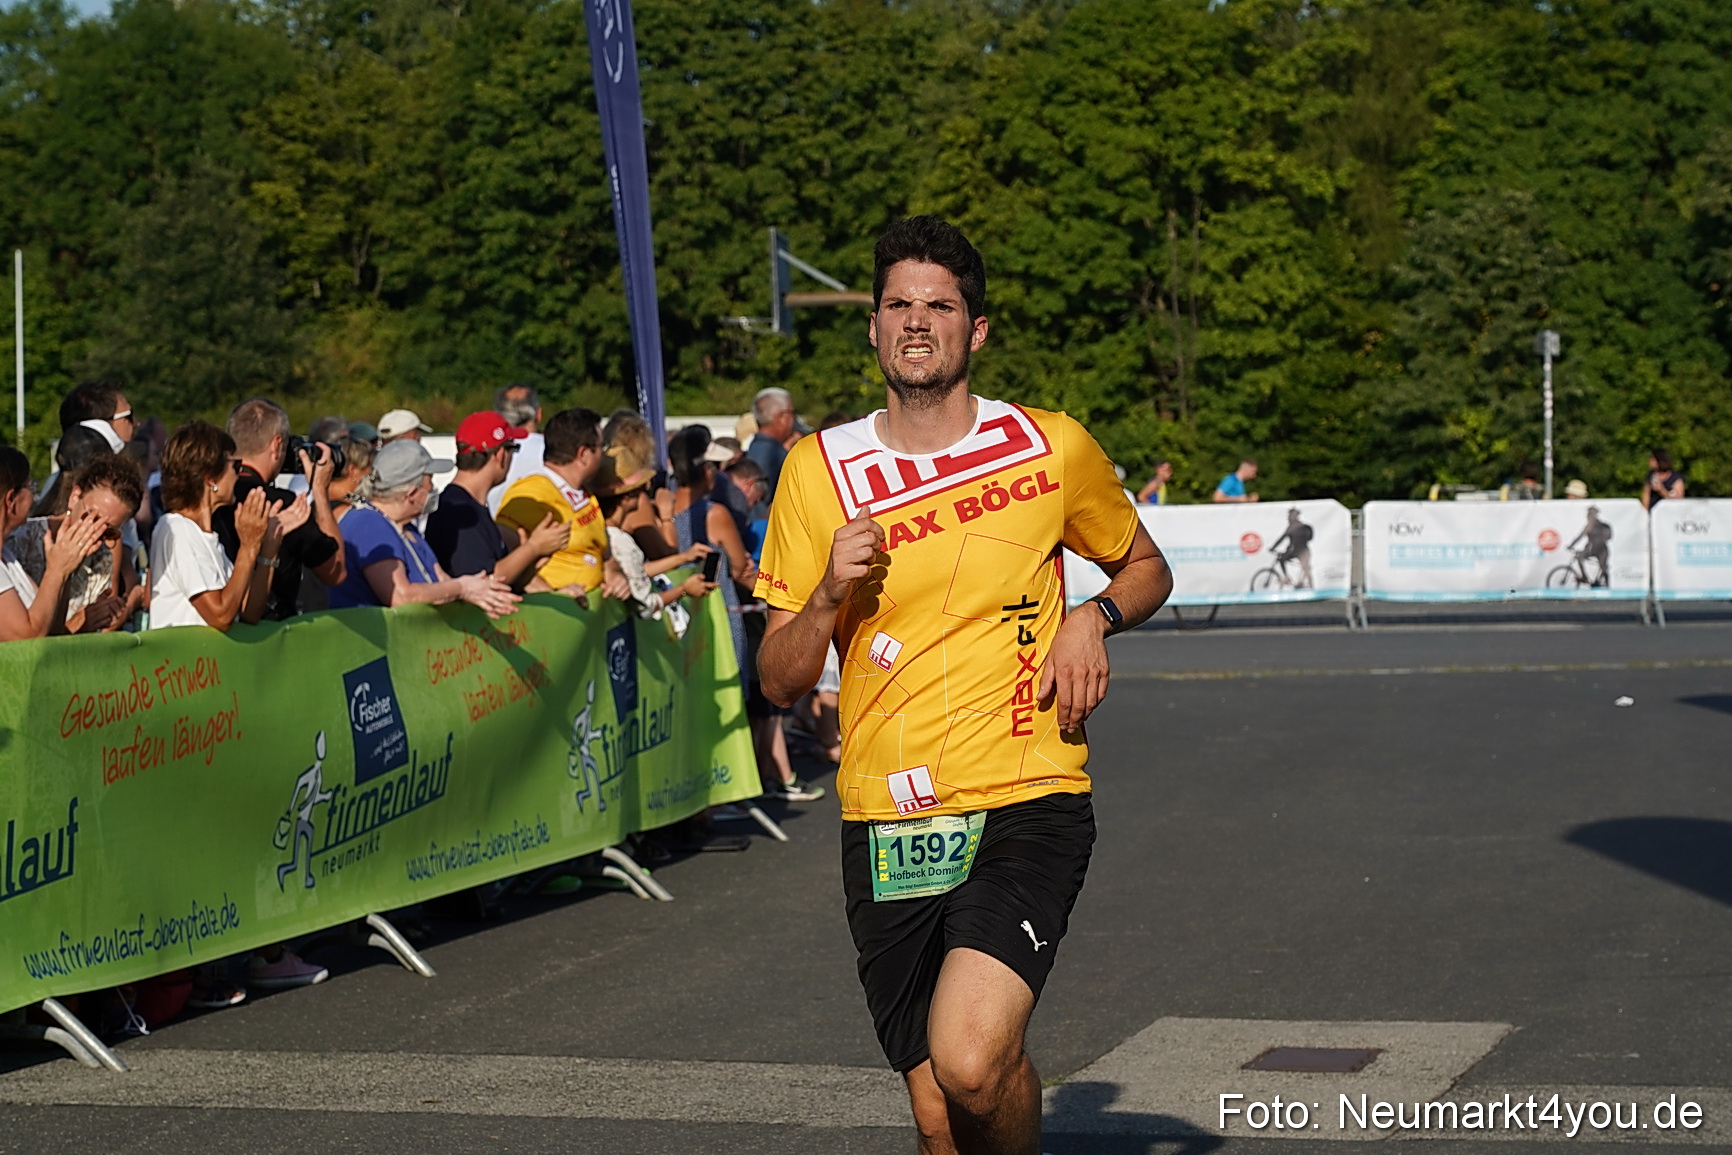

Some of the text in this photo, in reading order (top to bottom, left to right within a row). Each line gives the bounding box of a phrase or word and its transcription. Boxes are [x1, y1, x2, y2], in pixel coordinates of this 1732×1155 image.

[953, 470, 1060, 524] BÖGL
[60, 656, 221, 740] Gesunde Firmen
[359, 696, 393, 725] Fischer
[102, 690, 243, 786] laufen länger!
[324, 731, 454, 849] firmenlauf
[0, 796, 79, 898] lauf
[321, 831, 381, 878] neumarkt
[878, 849, 890, 882] RUN
[890, 831, 968, 868] 1592
[961, 833, 979, 873] 2022
[889, 867, 926, 882] Hofbeck
[23, 893, 240, 980] www.firmenlauf-oberpfalz.de
